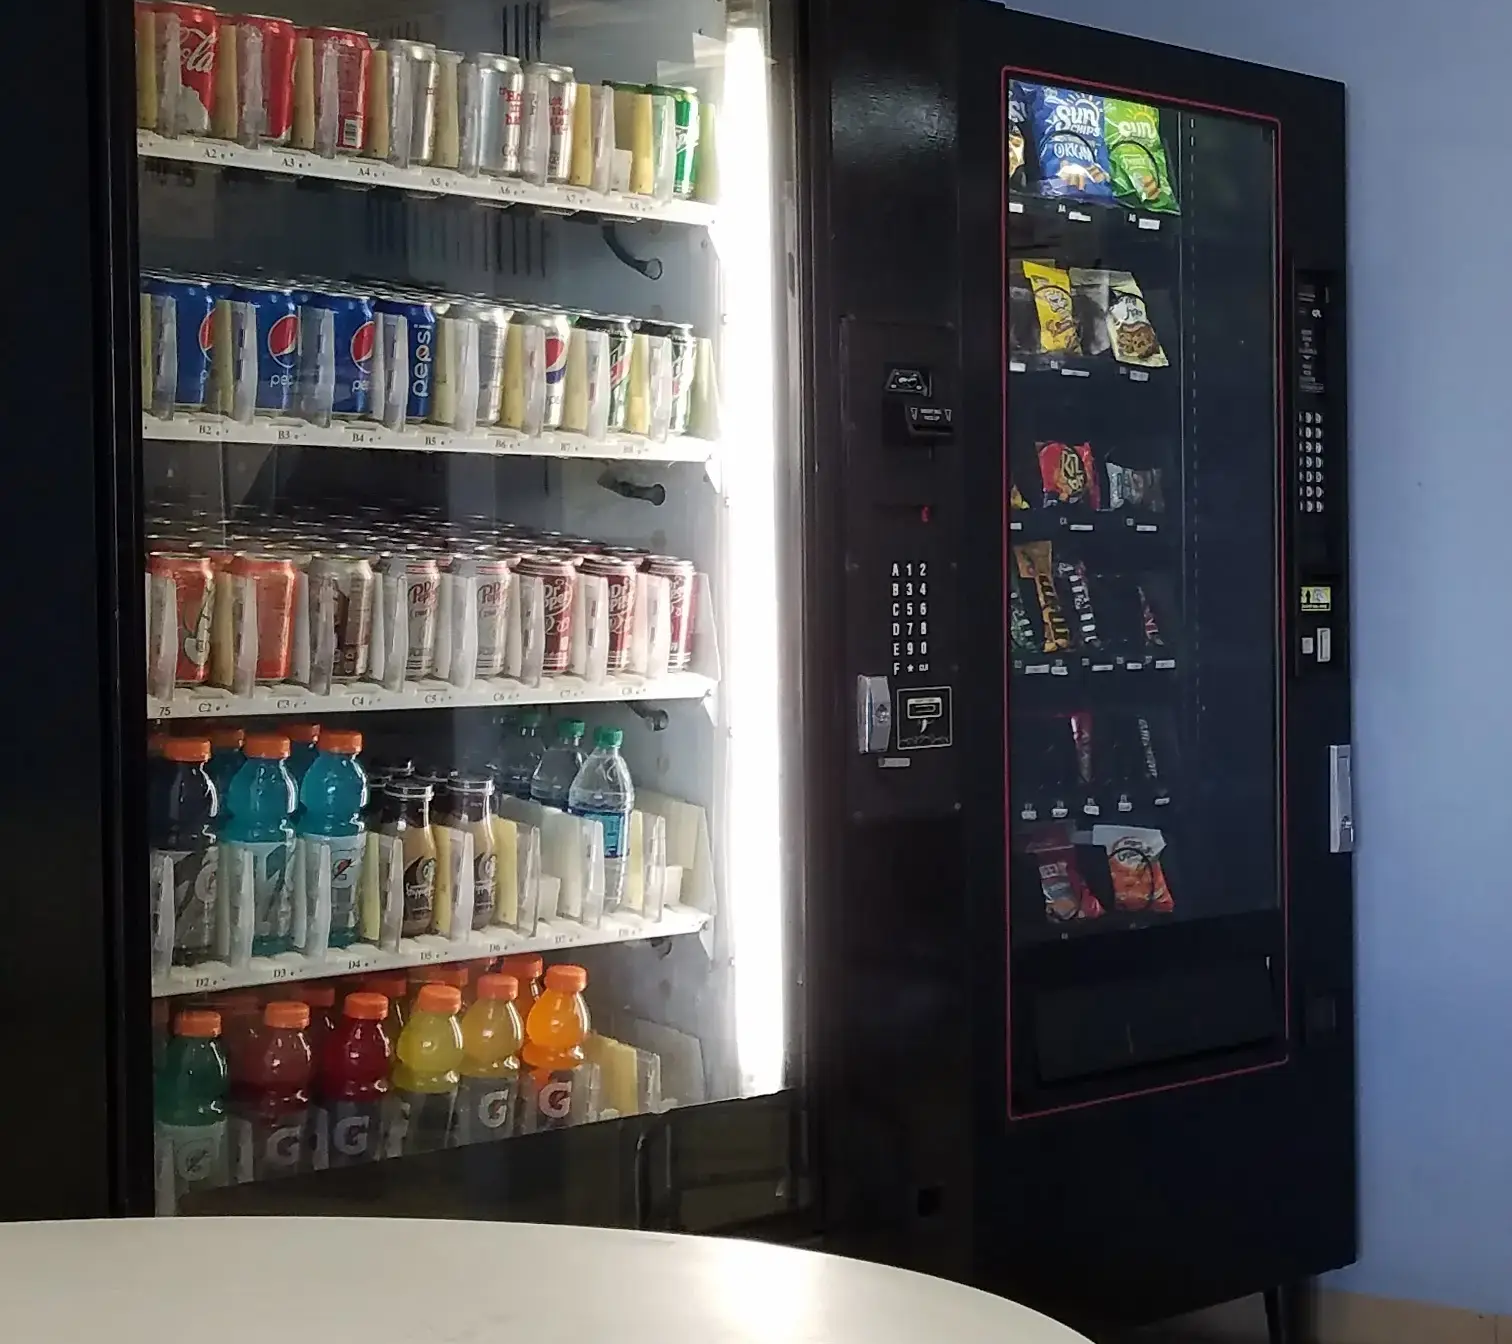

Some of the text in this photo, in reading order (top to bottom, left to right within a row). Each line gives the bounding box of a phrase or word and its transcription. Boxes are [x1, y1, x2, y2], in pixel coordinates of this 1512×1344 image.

[1071, 123, 1101, 137] CHIPS
[203, 149, 216, 158] A2
[282, 158, 295, 167] A3
[357, 167, 370, 177] A4
[429, 177, 441, 187] A5
[498, 186, 510, 196] A6
[564, 194, 576, 203] A7
[412, 324, 432, 397] pepsi
[199, 425, 212, 434] B2
[278, 430, 290, 439] B3
[352, 433, 365, 442] B4
[425, 437, 436, 446] B5
[495, 439, 507, 449] B6
[560, 443, 571, 451] B7
[892, 563, 926, 576] A 1 2
[892, 582, 927, 596] B 3 4
[892, 602, 927, 616] C 5 6
[892, 623, 900, 636] D
[906, 623, 913, 636] 7
[893, 641, 927, 656] E 9 0
[893, 663, 900, 676] F
[493, 693, 505, 702] C6
[560, 689, 571, 698] C7
[352, 697, 364, 706] C4
[424, 694, 436, 704] C5
[199, 703, 212, 713] C2
[277, 700, 290, 709] C3
[160, 707, 171, 716] 75
[489, 944, 501, 952] D6
[420, 952, 432, 960] D5
[348, 960, 361, 969] D4
[273, 968, 286, 978] D3
[195, 978, 209, 987] D2
[539, 1082, 572, 1119] G
[479, 1090, 509, 1128] G
[334, 1116, 369, 1155] G
[267, 1125, 302, 1166] G
